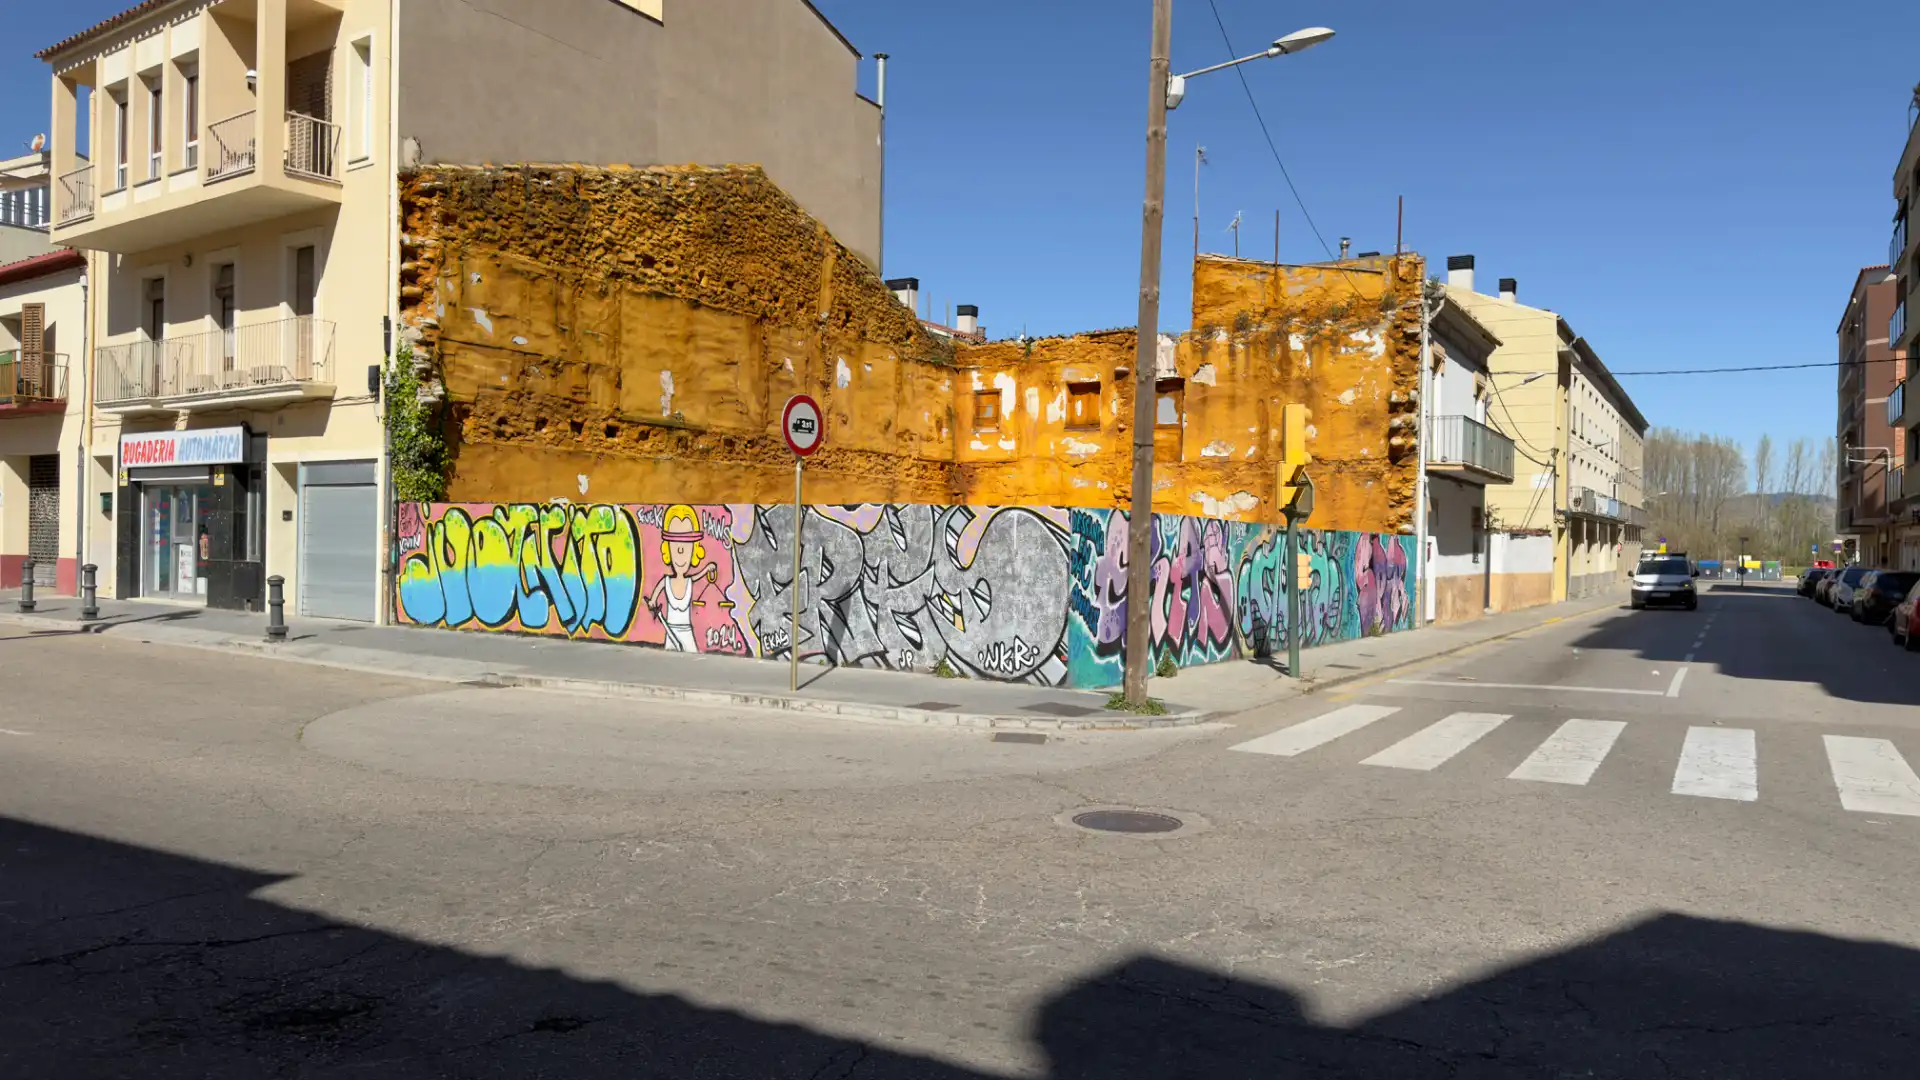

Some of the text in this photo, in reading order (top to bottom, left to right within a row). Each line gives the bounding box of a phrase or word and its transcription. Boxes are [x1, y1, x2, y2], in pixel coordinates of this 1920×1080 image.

[122, 438, 175, 464] BUGADERIA
[637, 505, 732, 550] FUCK LAWS
[763, 626, 790, 652] EKAS
